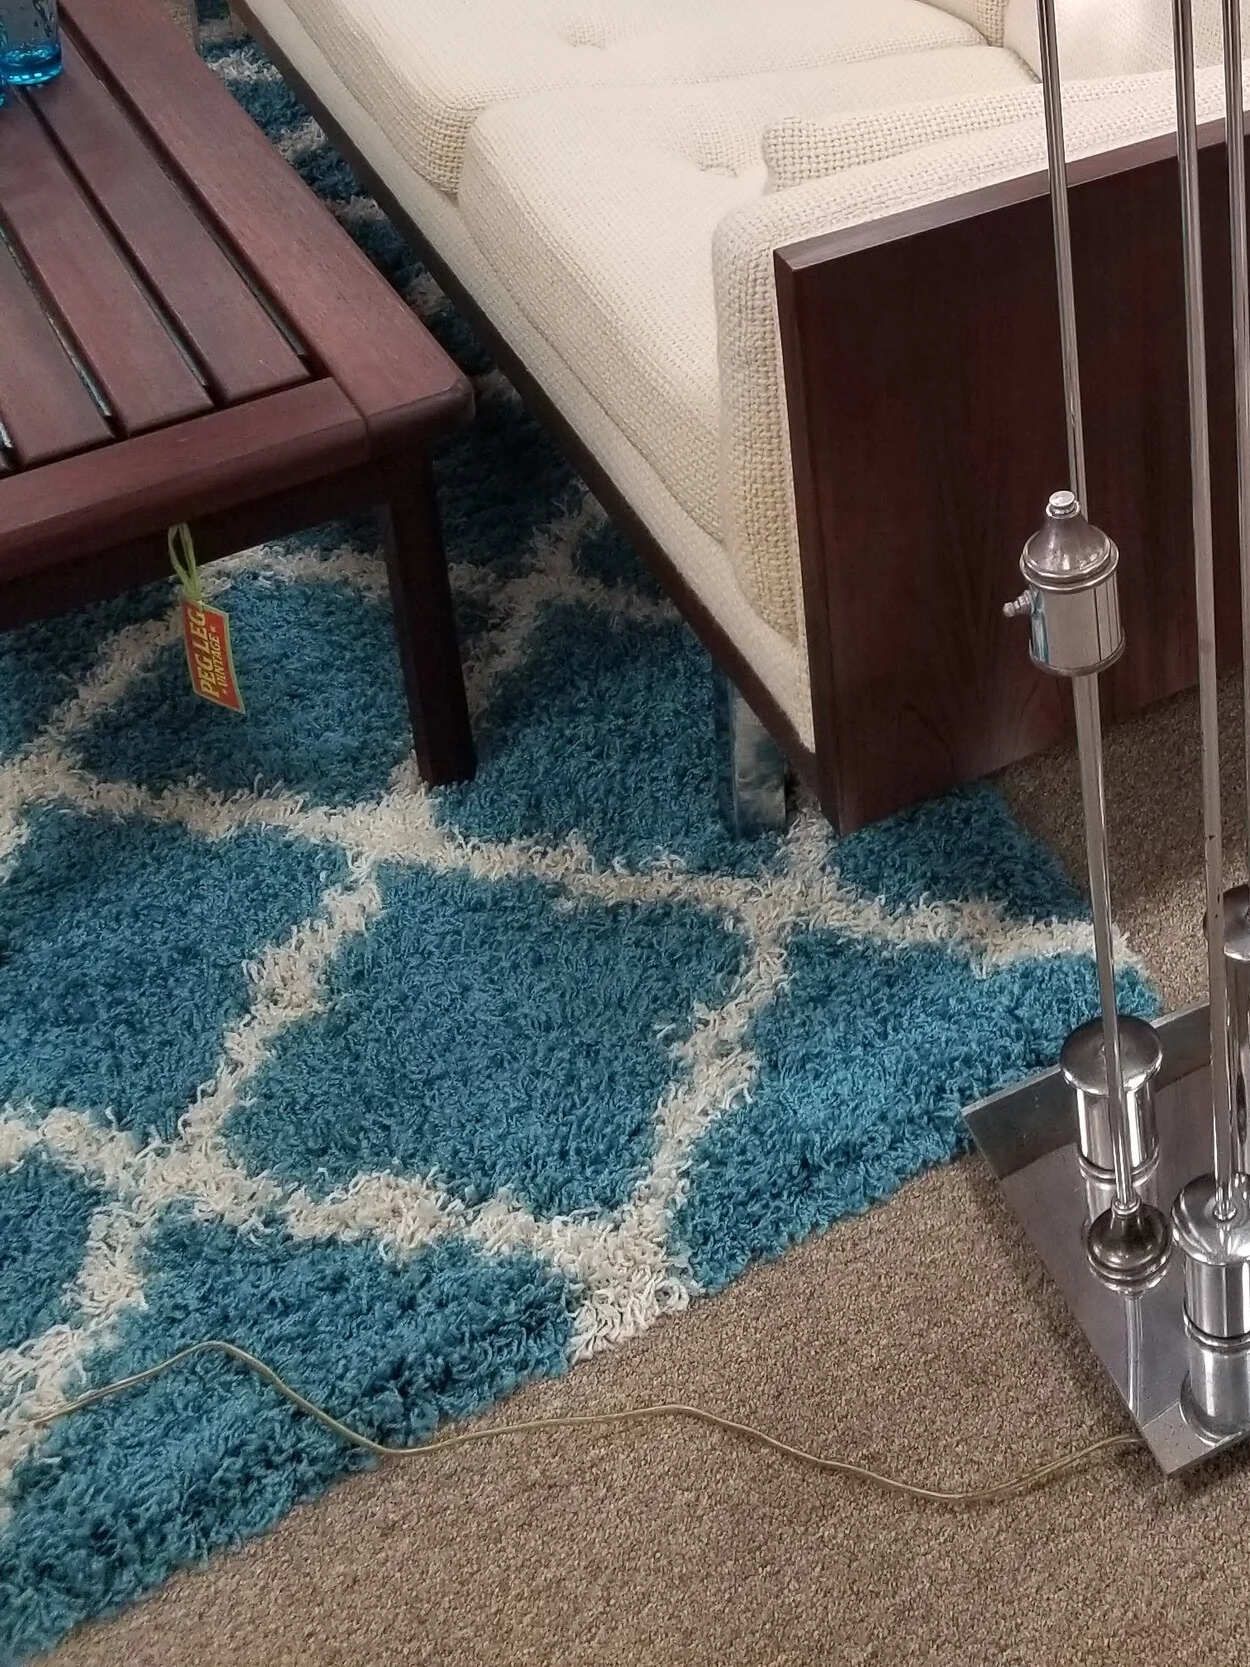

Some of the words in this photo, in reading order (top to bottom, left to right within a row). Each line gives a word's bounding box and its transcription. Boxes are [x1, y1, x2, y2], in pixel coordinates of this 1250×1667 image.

[187, 607, 211, 653] LEG
[194, 652, 220, 699] PEG
[207, 632, 229, 688] VINTAGE
